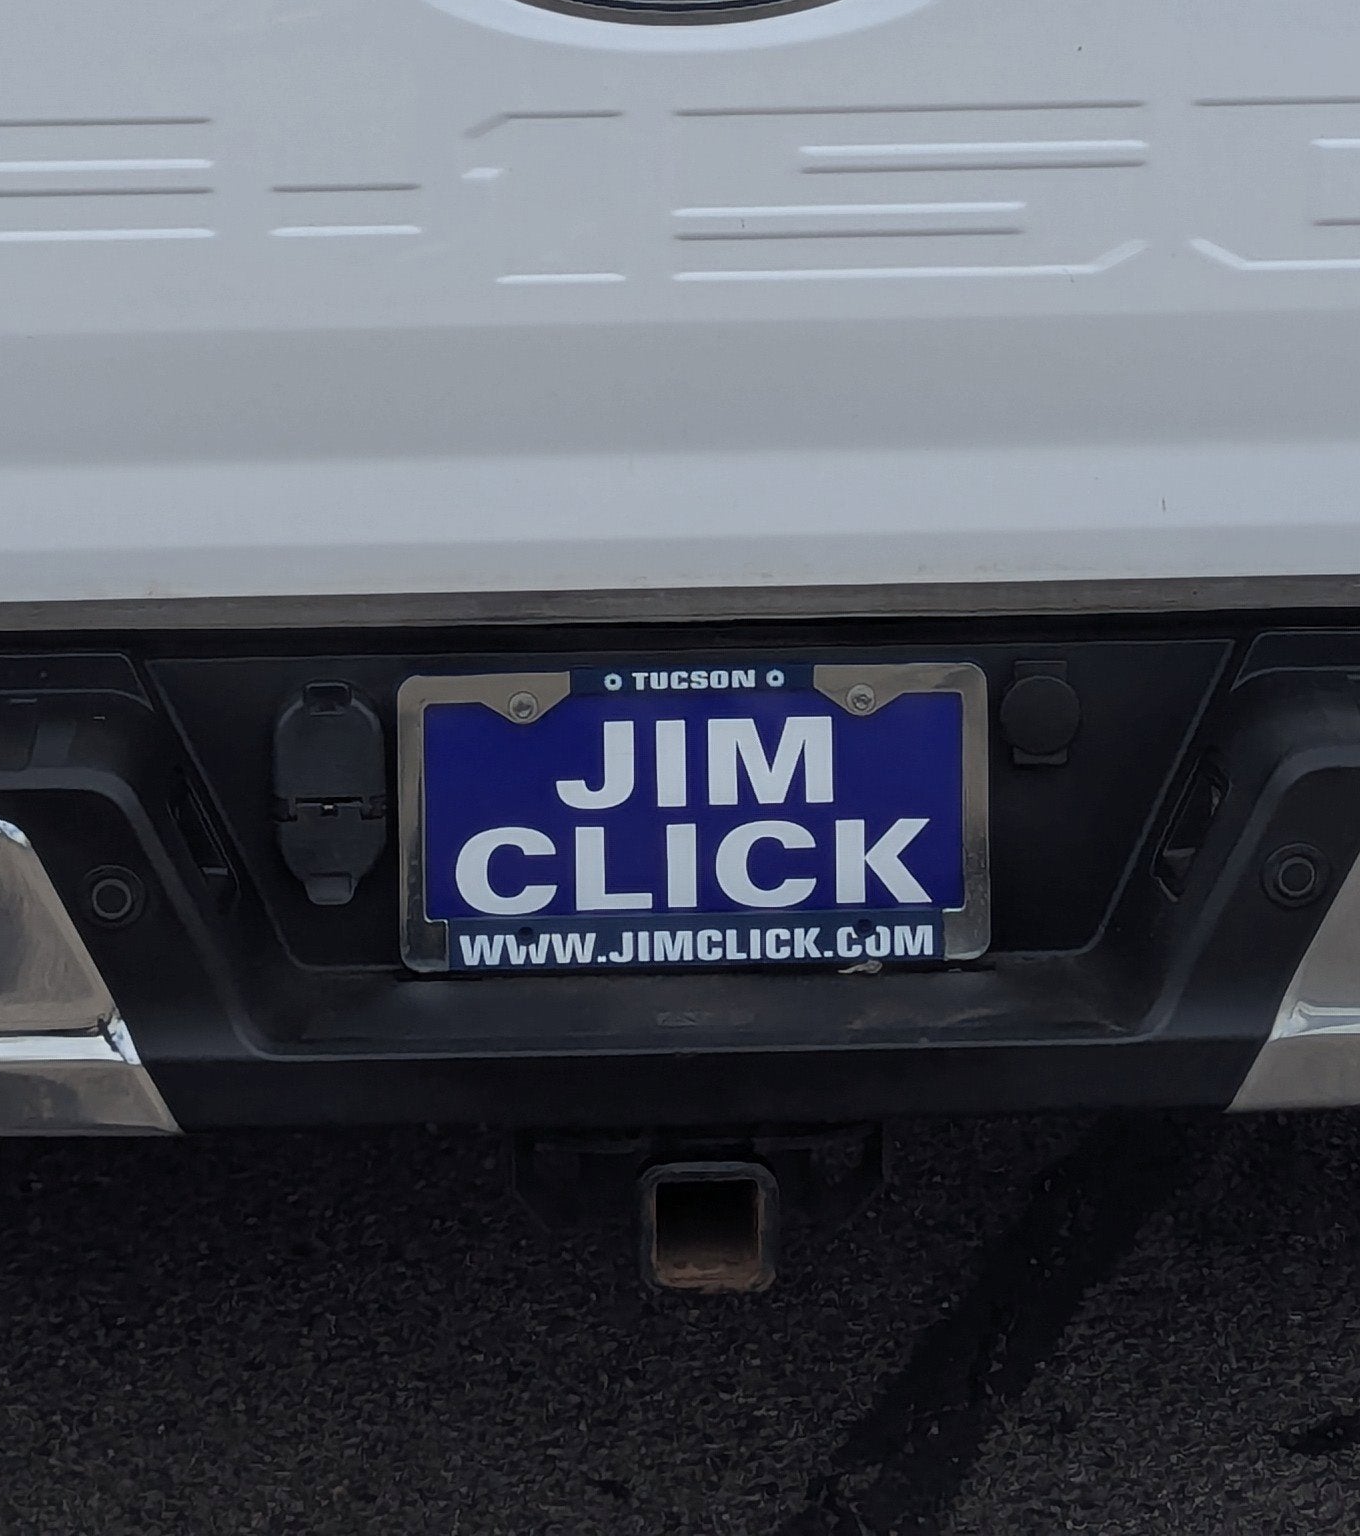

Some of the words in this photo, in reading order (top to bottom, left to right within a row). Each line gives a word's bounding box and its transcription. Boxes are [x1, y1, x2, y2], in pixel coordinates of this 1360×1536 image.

[631, 669, 756, 691] TUCSON
[555, 715, 834, 810] JIM
[454, 817, 933, 916] CLICK
[458, 924, 934, 967] WWW.JIMCLICK.COM
